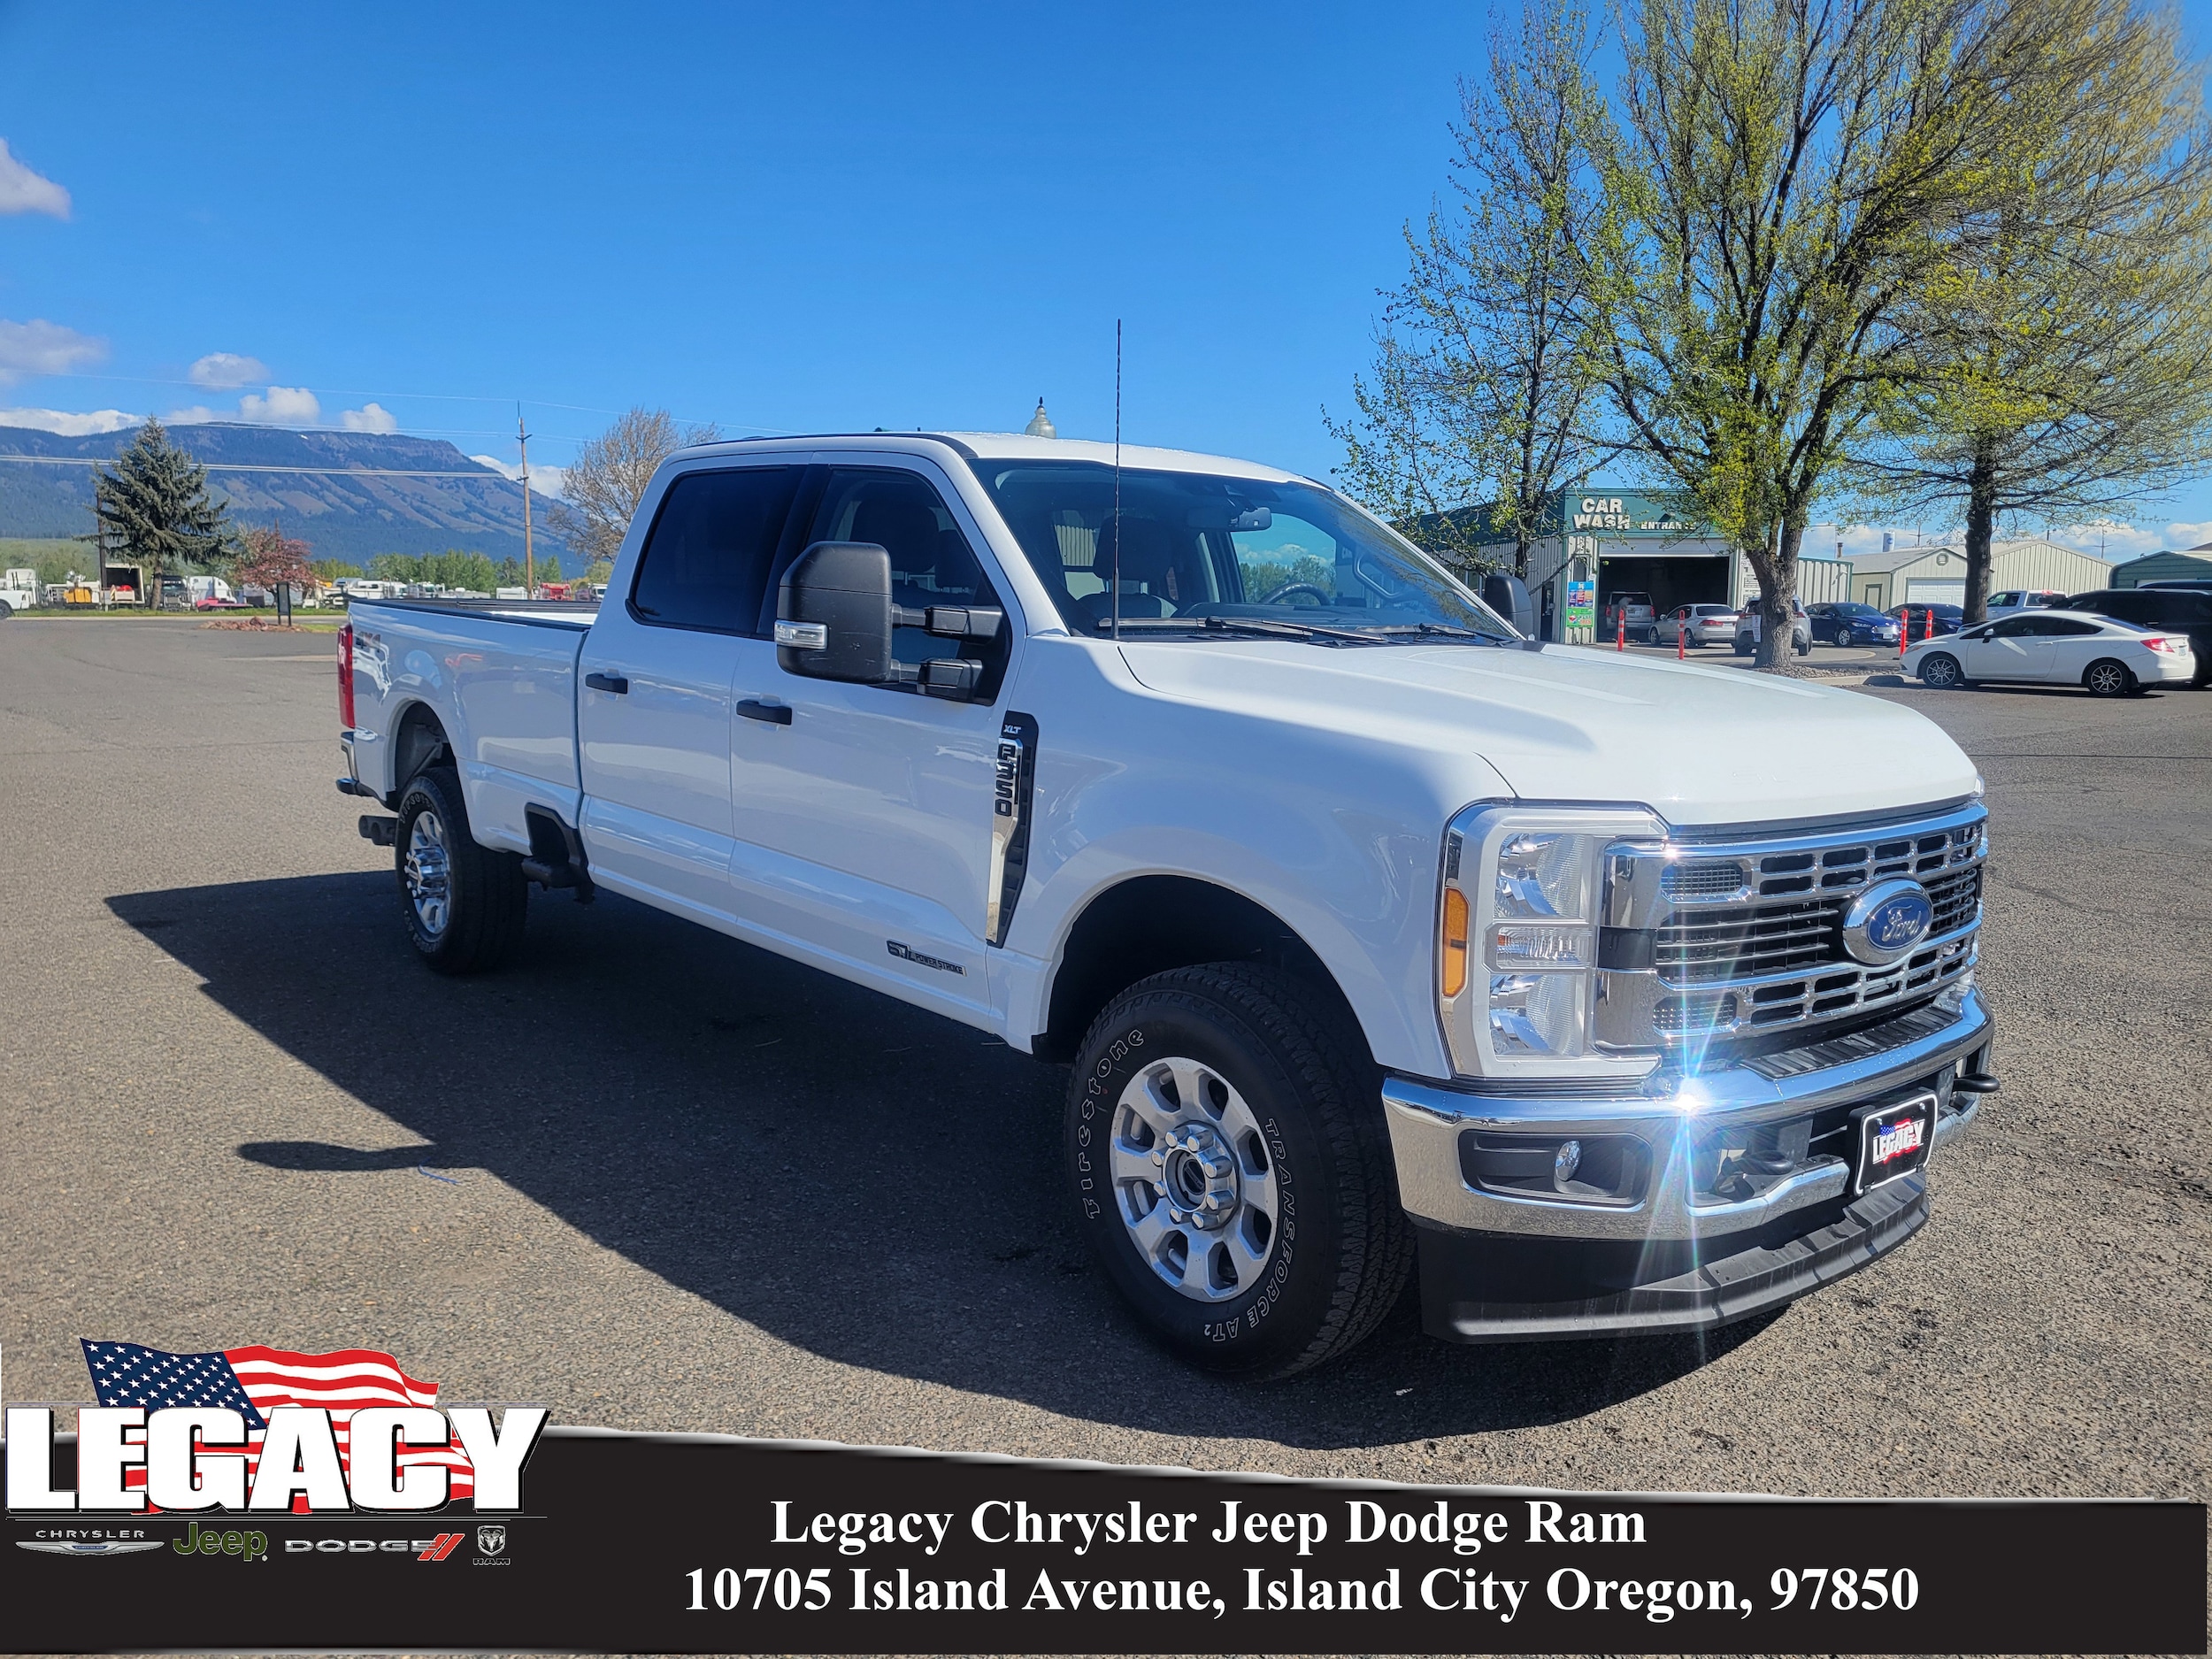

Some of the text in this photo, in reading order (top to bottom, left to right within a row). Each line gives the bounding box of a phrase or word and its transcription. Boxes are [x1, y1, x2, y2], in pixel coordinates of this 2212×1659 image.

[1581, 497, 1623, 513] CAR
[1573, 514, 1631, 529] WASH
[1003, 725, 1022, 734] XLT
[1881, 904, 1921, 942] Ford
[915, 954, 937, 967] POWER
[938, 960, 963, 974] STROKE
[1873, 1121, 1924, 1161] LEGACY
[1247, 1118, 1296, 1328] TRANSFORCE
